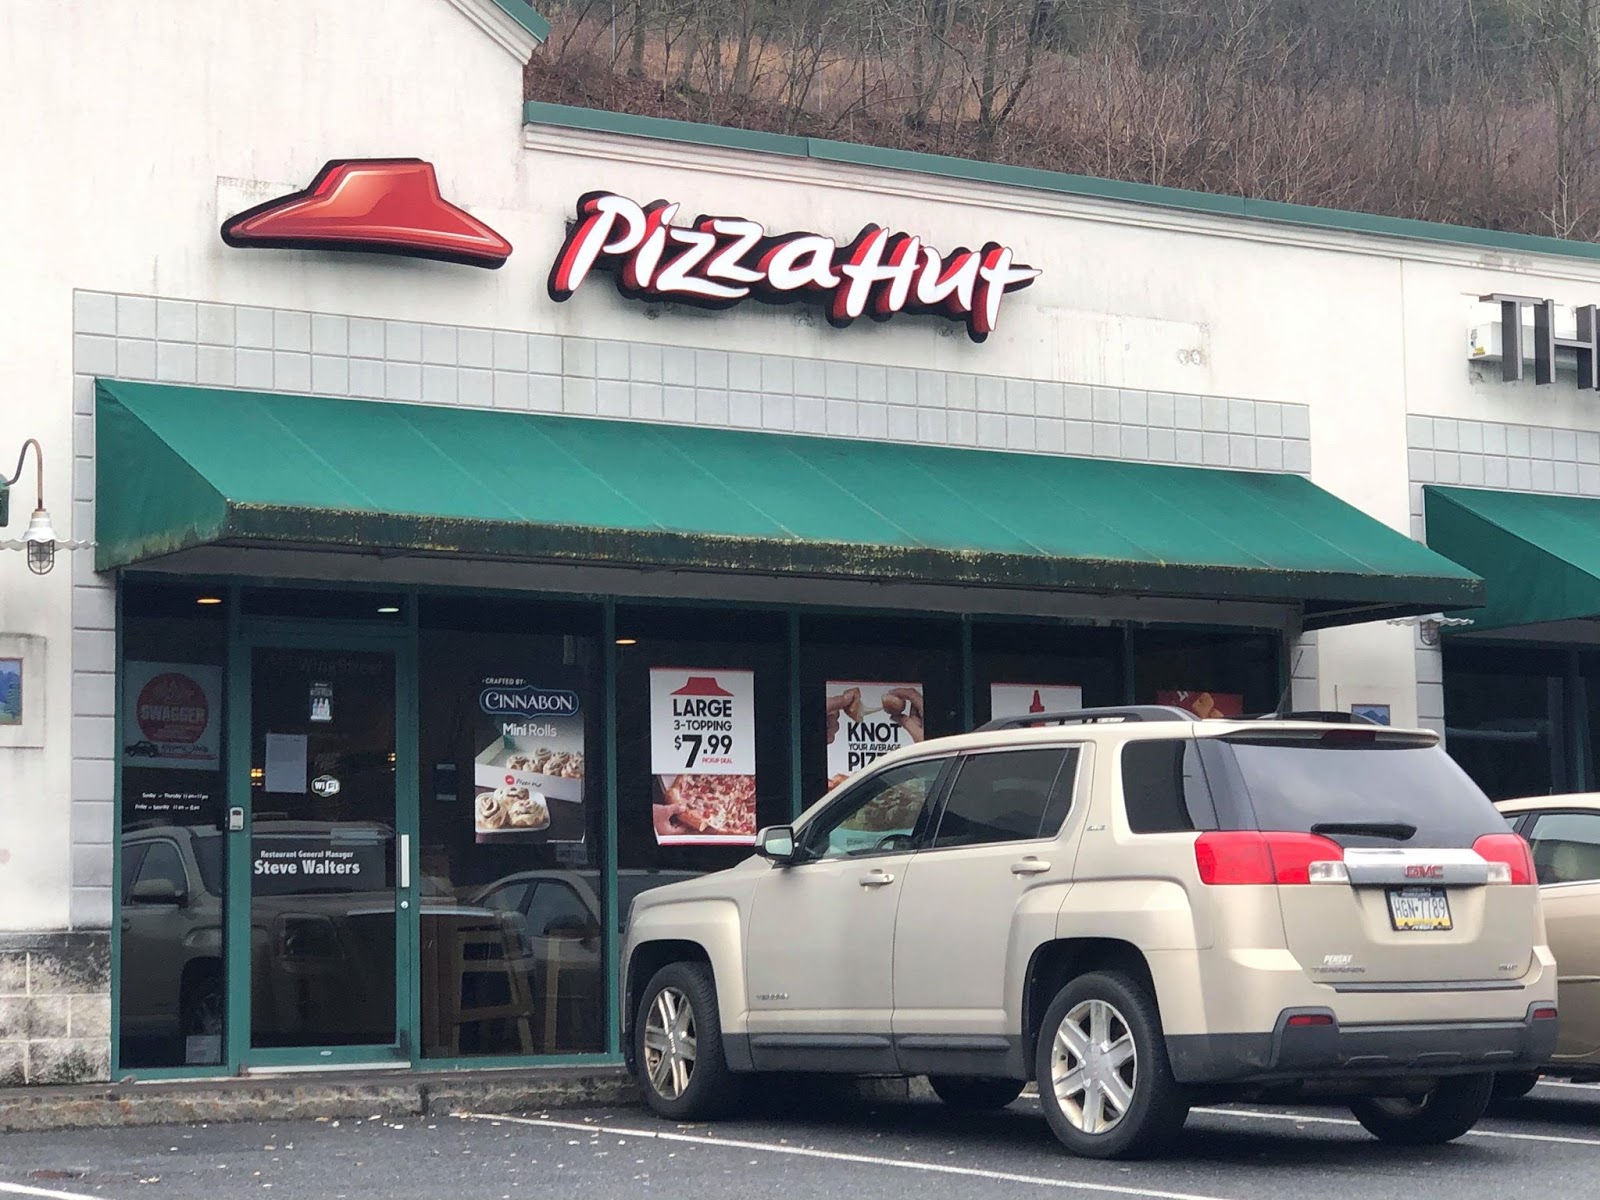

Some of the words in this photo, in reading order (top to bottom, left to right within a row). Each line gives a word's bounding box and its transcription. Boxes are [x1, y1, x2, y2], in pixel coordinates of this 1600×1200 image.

[556, 195, 841, 298] Pizza
[831, 226, 1043, 333] Hut
[1478, 292, 1600, 392] TH
[485, 691, 573, 711] CINNABON
[673, 698, 732, 717] LARGE
[502, 722, 527, 736] Mini
[528, 723, 557, 737] Rolls
[673, 720, 733, 731] 3-TOPPING
[847, 721, 902, 742] KNOT
[674, 734, 733, 768] $7.99
[848, 743, 868, 751] YOUR
[260, 850, 297, 858] Restaurant
[298, 850, 325, 858] General
[325, 850, 354, 859] Manager
[254, 859, 298, 875] Steve
[301, 859, 361, 875] Walters
[1404, 865, 1444, 878] GMC
